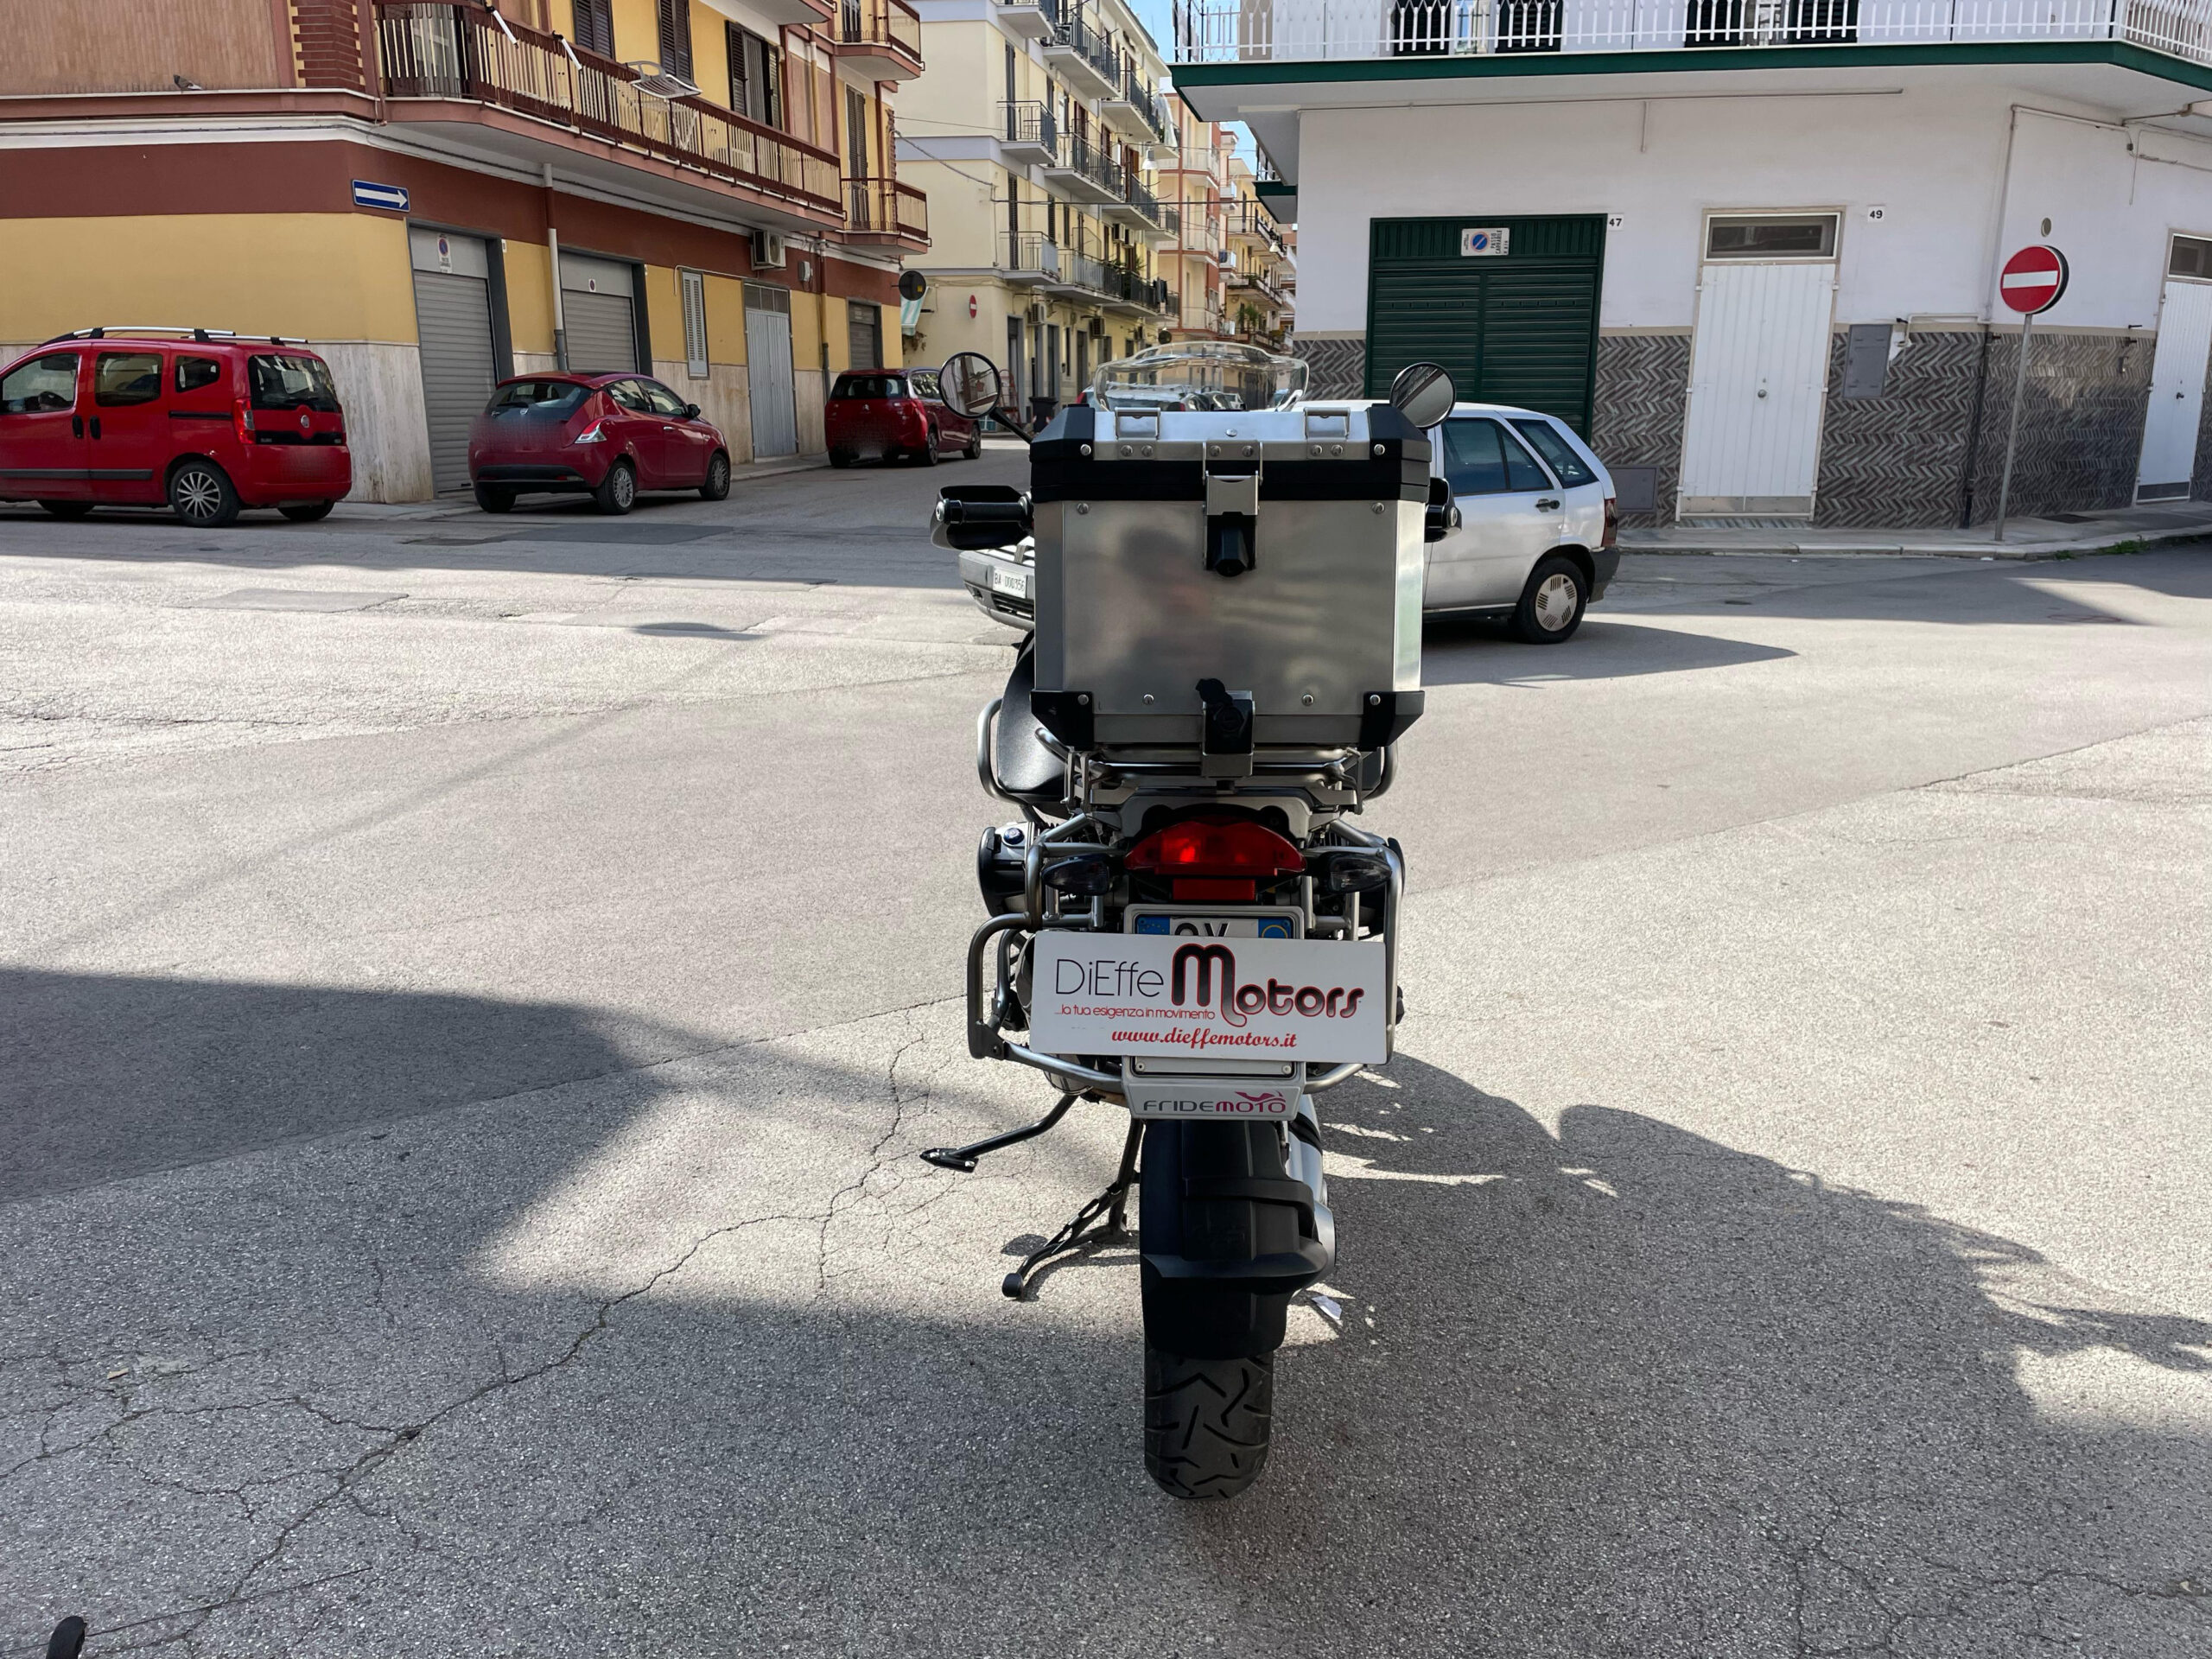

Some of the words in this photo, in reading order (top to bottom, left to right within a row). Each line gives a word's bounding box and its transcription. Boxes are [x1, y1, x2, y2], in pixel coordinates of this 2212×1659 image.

[1869, 209, 1883, 219] 49
[1609, 218, 1623, 227] 47
[1056, 958, 1165, 997] DiEffe
[1171, 943, 1365, 1027] Motors
[1073, 1004, 1091, 1016] tua
[1092, 1007, 1144, 1020] esigenza
[1146, 1007, 1154, 1017] in
[1155, 1008, 1216, 1020] movimento
[1111, 1027, 1297, 1049] www.dieffemotors.it
